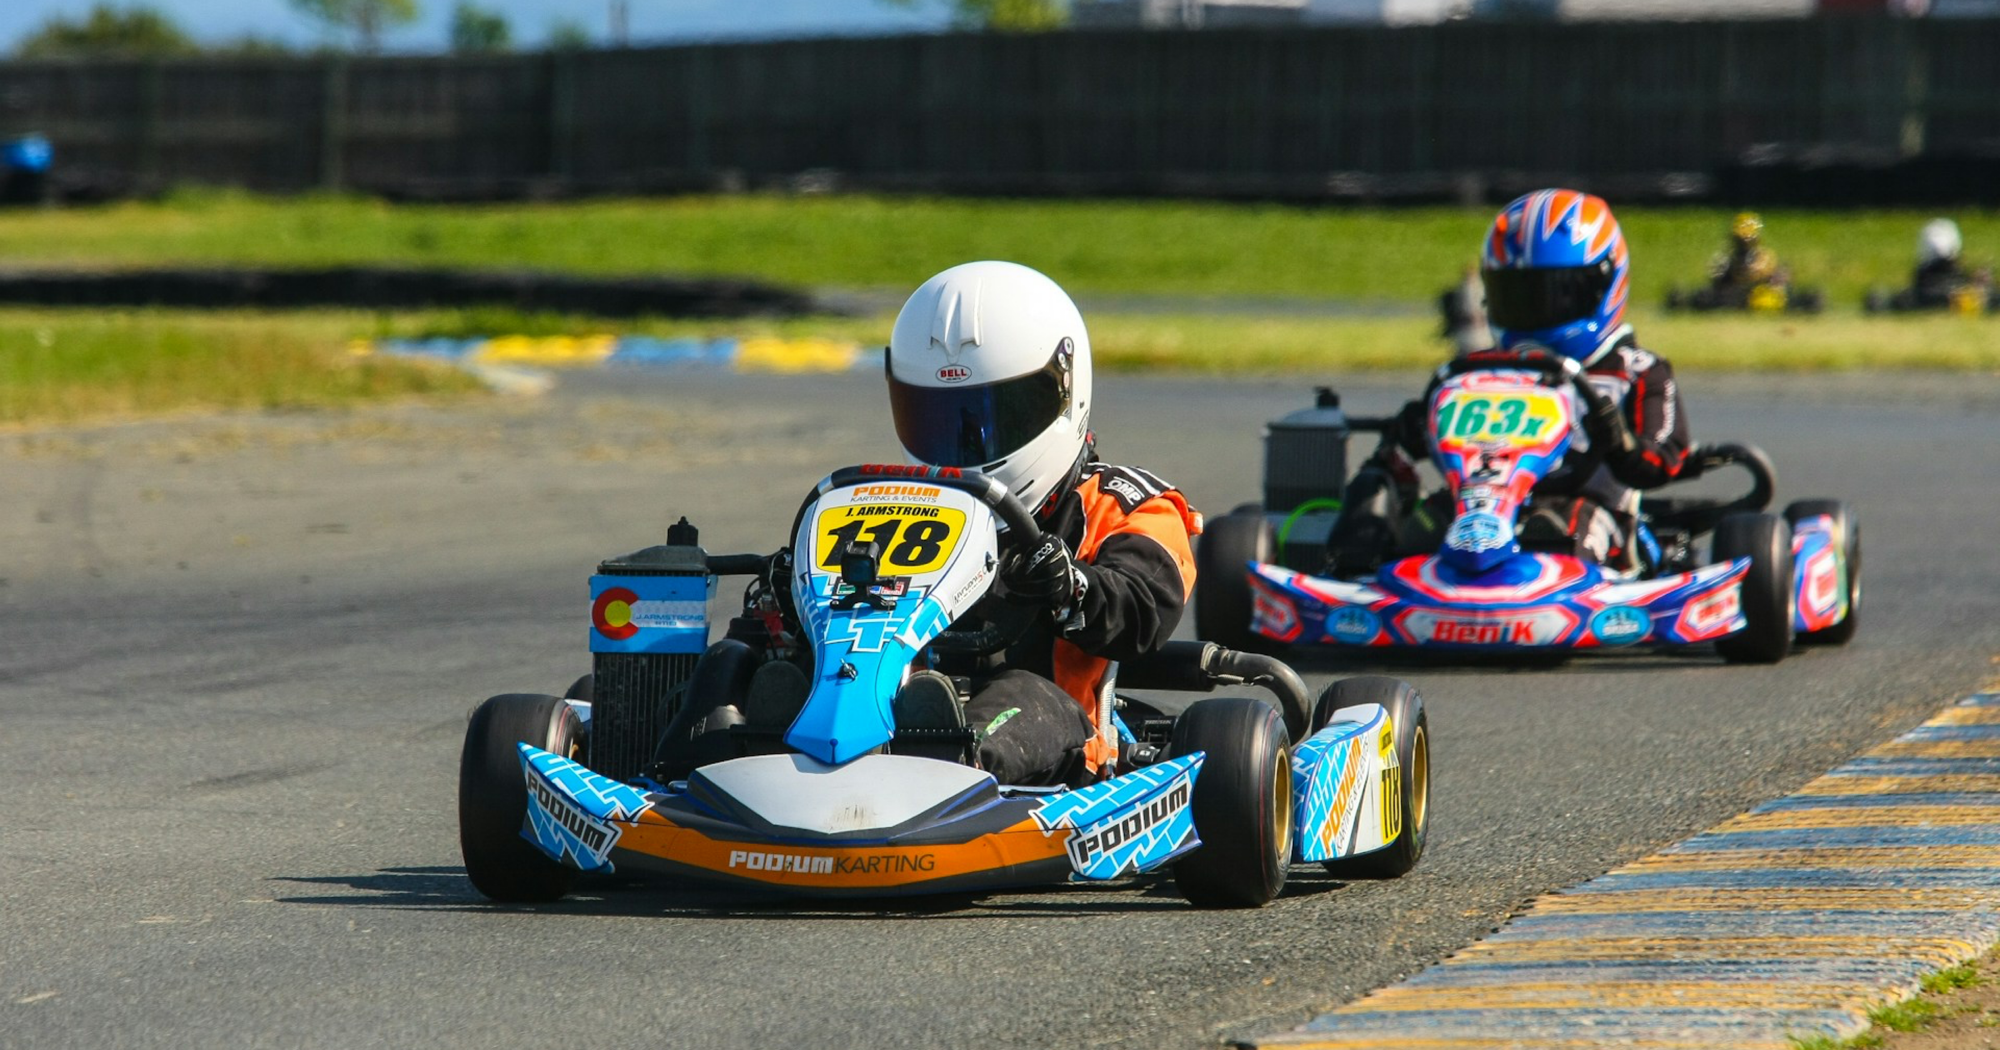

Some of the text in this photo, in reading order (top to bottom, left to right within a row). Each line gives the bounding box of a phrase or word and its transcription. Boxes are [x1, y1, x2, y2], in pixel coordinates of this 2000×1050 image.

[941, 368, 967, 378] BELL
[850, 495, 890, 503] KARTING
[853, 486, 941, 498] PODIUM
[1107, 479, 1142, 502] OMP
[845, 506, 940, 518] J. ARMSTRONG
[822, 519, 950, 567] 118
[1322, 735, 1362, 857] PODIUM
[1381, 749, 1400, 839] 118
[527, 770, 607, 855] PODIUM
[1077, 782, 1189, 864] PODIUM
[729, 850, 935, 874] PODIUM KARTING
